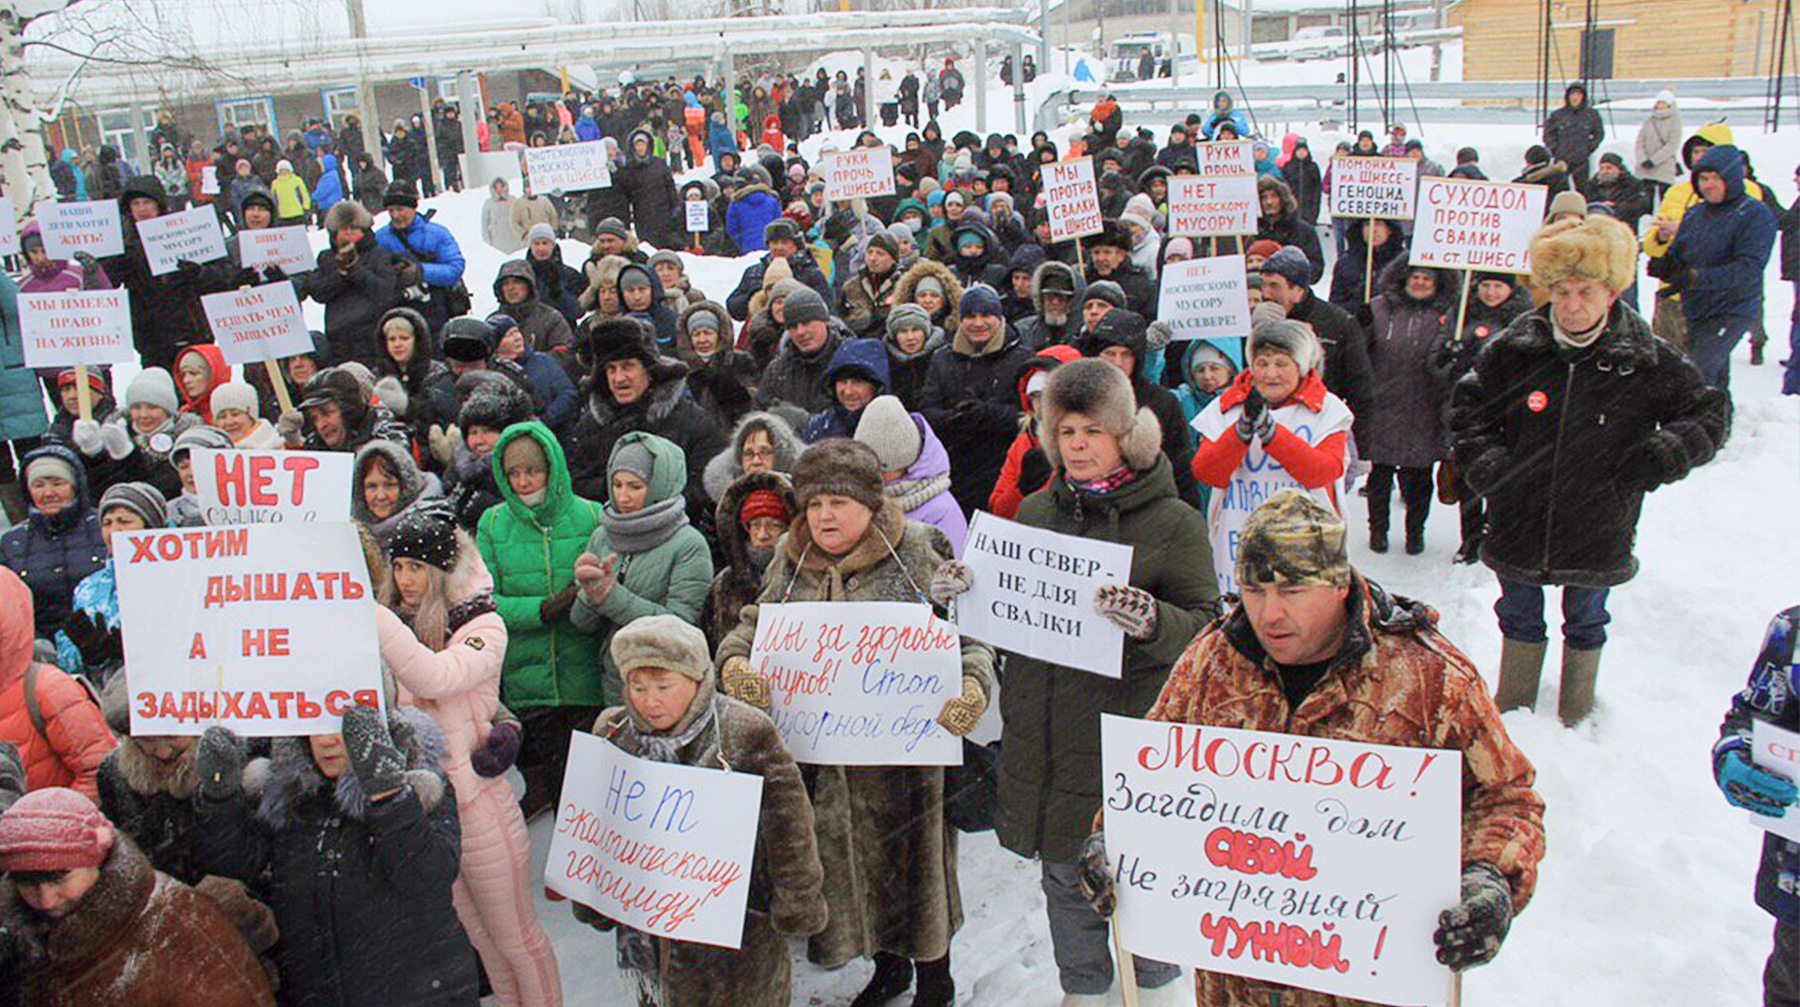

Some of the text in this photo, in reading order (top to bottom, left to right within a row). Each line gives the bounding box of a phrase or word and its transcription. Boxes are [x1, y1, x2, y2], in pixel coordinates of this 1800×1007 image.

[837, 153, 868, 167] РУКИ
[1206, 145, 1240, 161] РУКИ
[834, 168, 874, 182] ПРОЧЬ
[844, 176, 892, 196] ШИЕСА!
[1050, 181, 1093, 201] ПРОТИВ
[1184, 184, 1216, 198] НЕТ
[1338, 184, 1404, 200] ГЕНОЦИД
[1428, 184, 1526, 210] СУХОДОЛ
[60, 208, 92, 216] НАШИ
[1053, 200, 1096, 220] СВАЛКИ
[1172, 202, 1250, 213] МОСКОВСКОМУ
[48, 222, 73, 230] ДЕТИ
[1434, 209, 1500, 228] ПРОТИВ
[60, 234, 103, 245] ЖИТЬ!
[163, 236, 202, 249] МУСОРУ
[1433, 228, 1500, 246] СВАЛКИ
[1166, 280, 1239, 294] МОСКОВСКОМУ
[29, 297, 119, 310] МЫ ИМЕЕМ
[235, 294, 265, 308] НАМ
[1176, 297, 1224, 310] МУСОРУ
[50, 317, 102, 328] ПРАВО
[215, 305, 295, 328] РЕШАТЬ ЧЕМ
[1186, 314, 1236, 328] СЕВЕРЕ!
[36, 334, 120, 348] НА ЖИЗНЬ!
[234, 324, 290, 343] ДЫШАТЬ!
[215, 453, 320, 508] НЕТ
[129, 528, 248, 564] ХОТИМ
[974, 532, 1022, 560] НАШ
[1028, 547, 1101, 578] СЕВЕР
[204, 572, 364, 609] ДЫШАТЬ
[998, 571, 1078, 606] НЕ ДЛЯ
[991, 600, 1082, 637] СВАЛКИ
[188, 629, 290, 659] А НЕ
[756, 616, 808, 651] Мы
[812, 623, 850, 662] за
[759, 655, 944, 705] внуков! Стоп
[136, 690, 379, 724] ЗАДЫХАТЬСЯ
[605, 764, 699, 833] Нет
[1108, 773, 1416, 842] Загадила дом
[1204, 826, 1317, 881] СВОЙ
[1115, 854, 1397, 922] Не загрязняй
